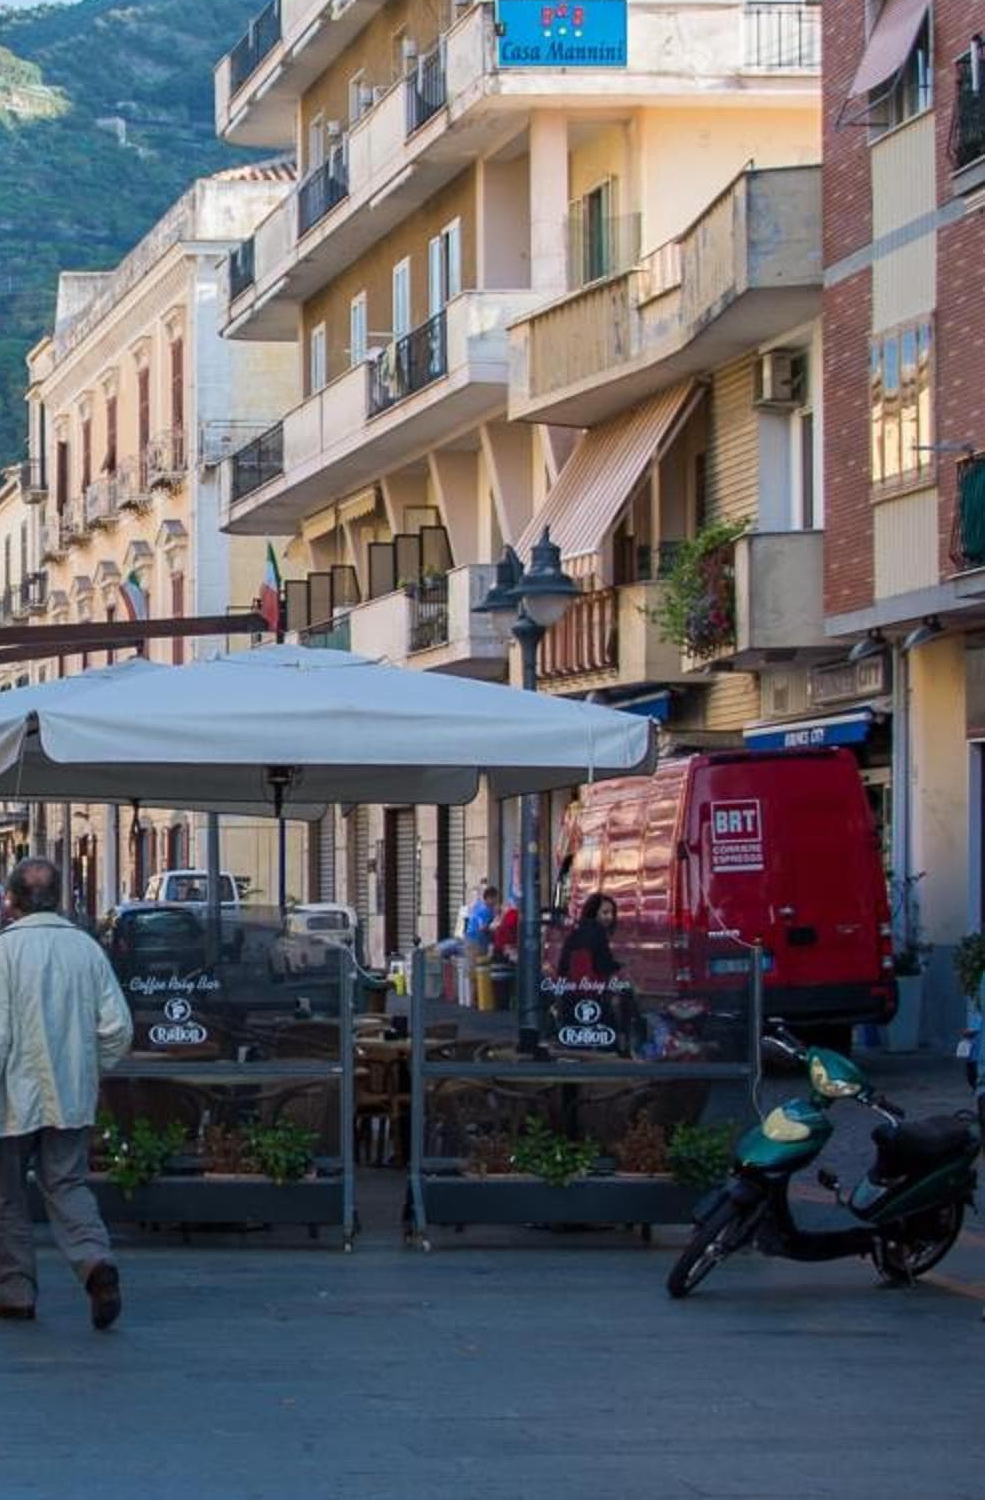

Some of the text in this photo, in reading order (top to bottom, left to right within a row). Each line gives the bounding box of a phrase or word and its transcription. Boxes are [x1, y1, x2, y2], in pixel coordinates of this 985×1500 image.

[501, 40, 625, 61] Casa Mannini
[715, 809, 756, 833] BRT
[712, 843, 762, 855] CORRIERE
[713, 853, 763, 864] ESPRESSO
[130, 976, 167, 995] Coffee
[197, 975, 221, 989] Bar
[540, 976, 577, 995] Coffee
[608, 975, 631, 989] Bar
